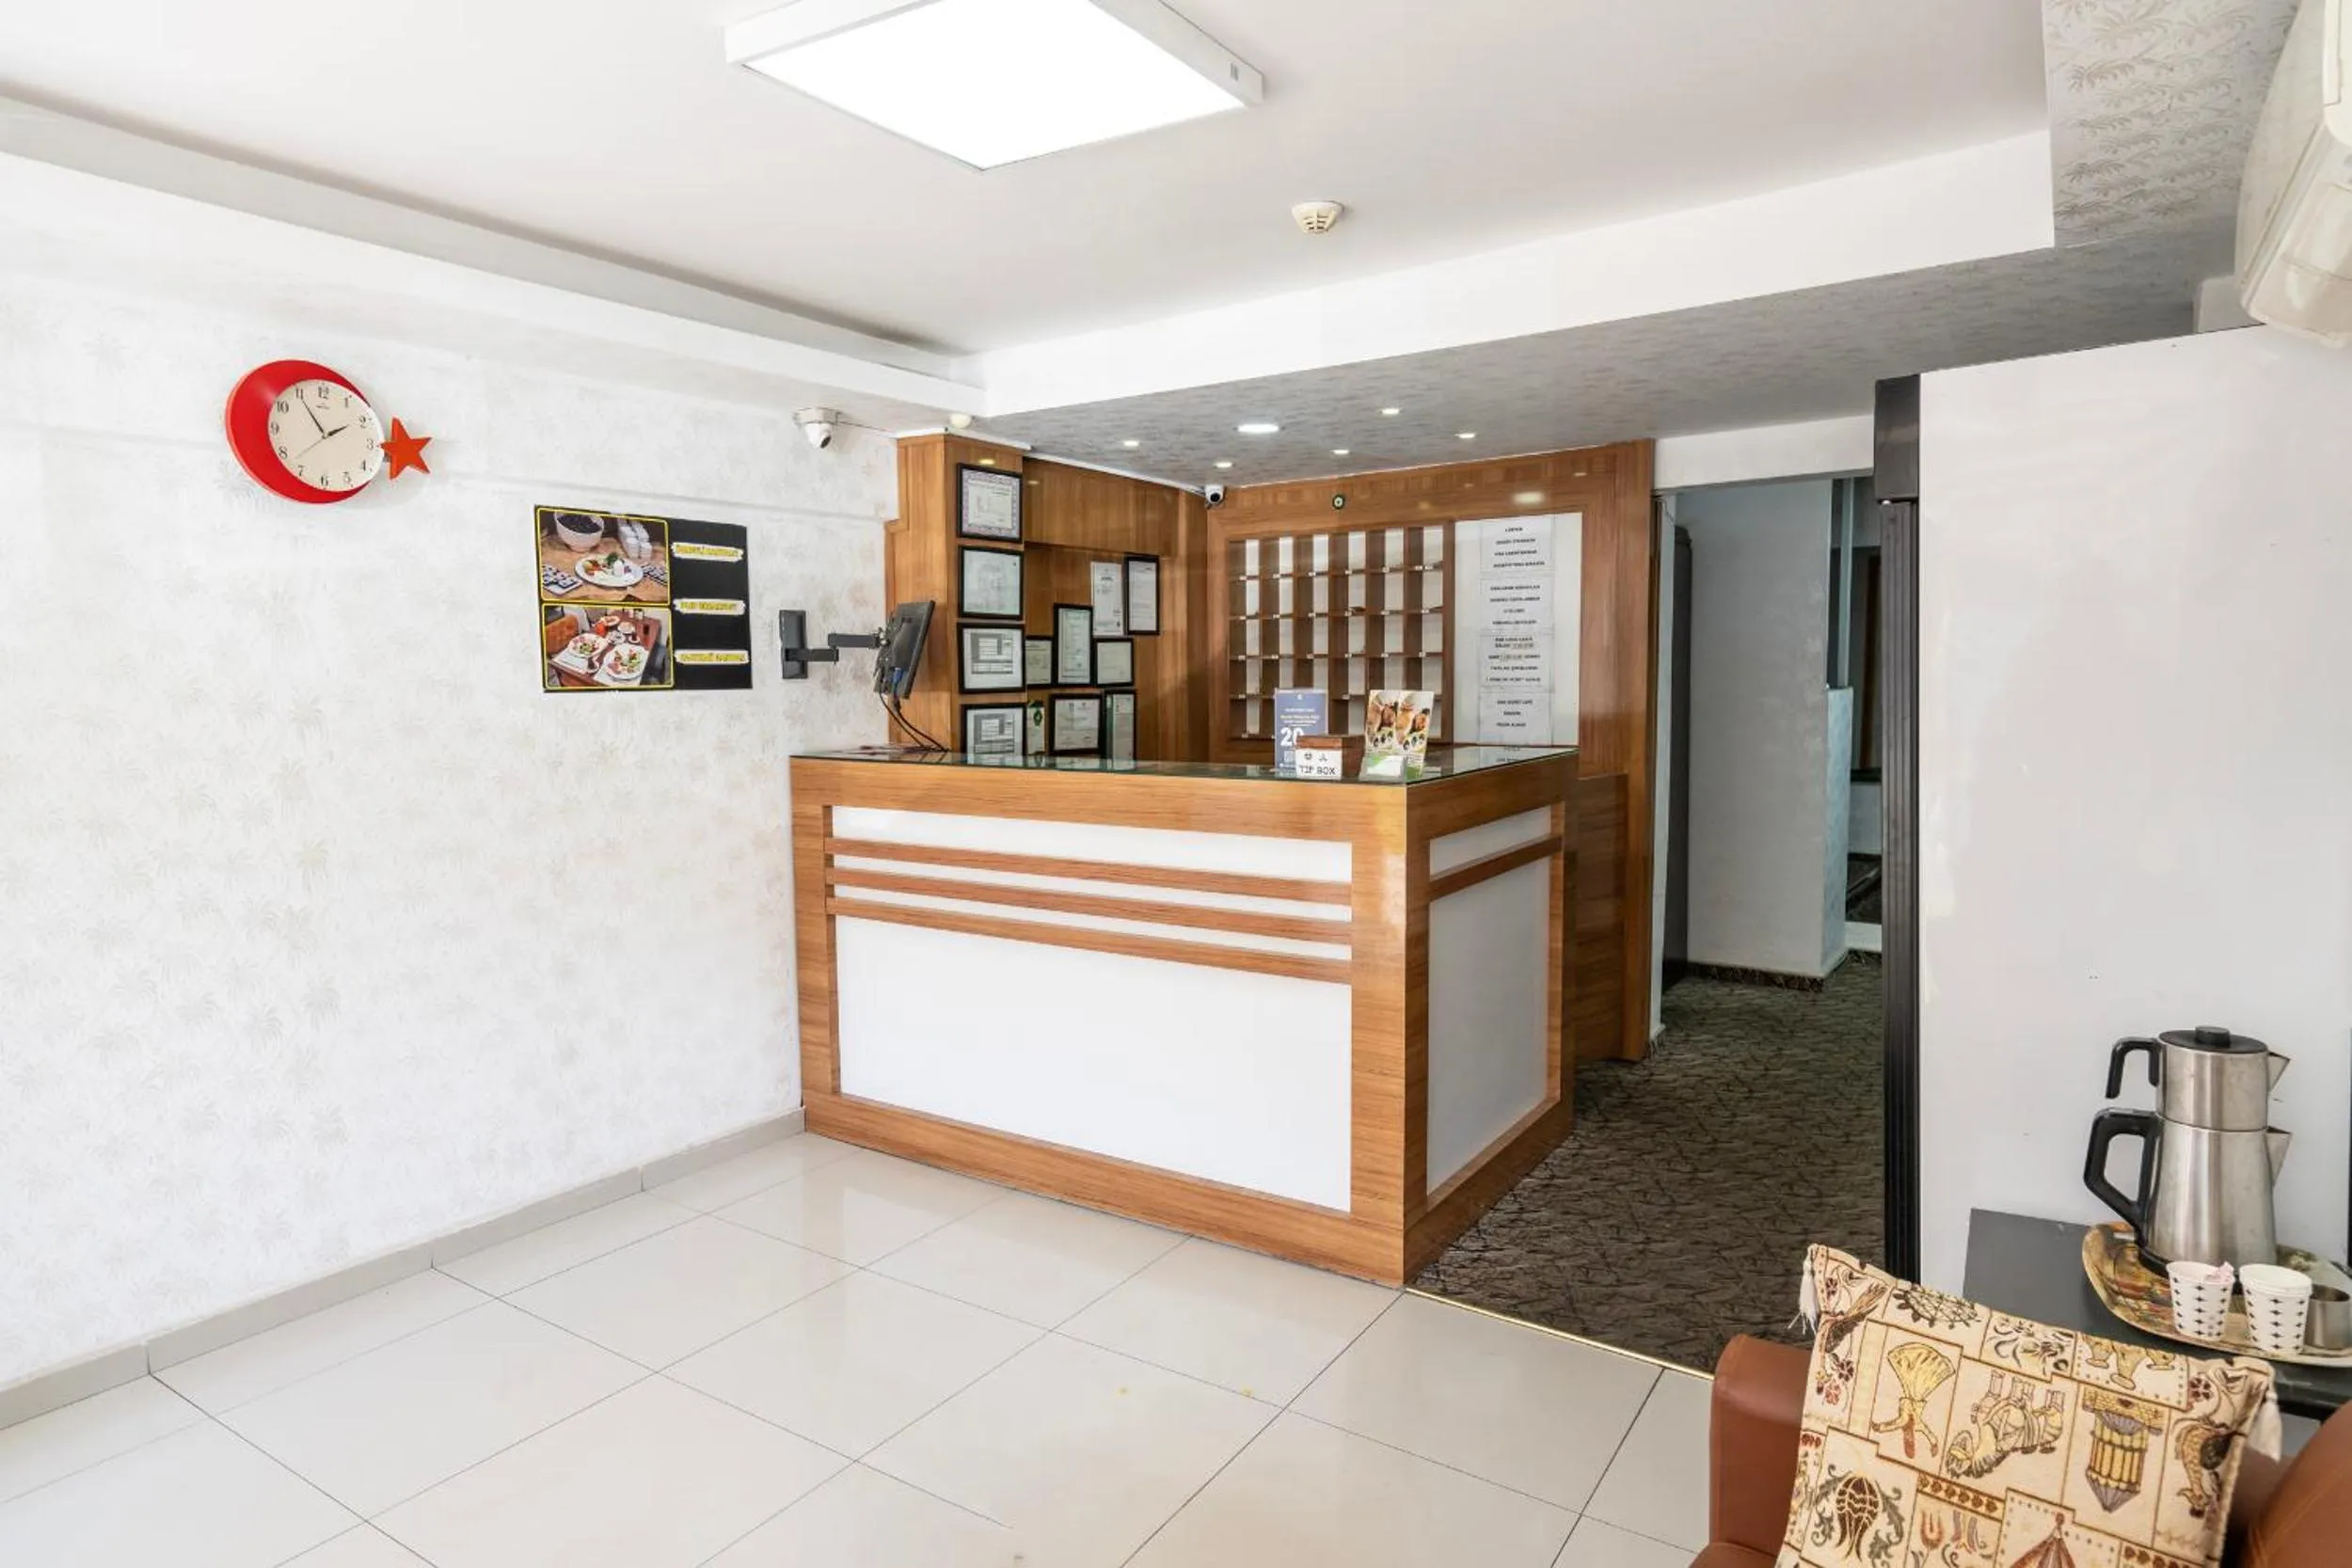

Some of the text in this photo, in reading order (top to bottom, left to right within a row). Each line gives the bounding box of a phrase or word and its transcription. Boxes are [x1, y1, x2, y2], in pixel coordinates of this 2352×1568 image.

[296, 388, 304, 400] 11
[318, 387, 329, 399] 12
[278, 400, 289, 414] 10
[344, 397, 350, 408] 1
[358, 415, 367, 429] 2
[270, 422, 279, 436] 9
[366, 437, 374, 451] 3
[278, 446, 288, 460] 8
[298, 466, 307, 476] 7
[360, 460, 367, 472] 4
[320, 475, 329, 487] 6
[343, 472, 352, 483] 5
[1300, 766, 1314, 775] TIP
[1317, 767, 1336, 776] BOX
